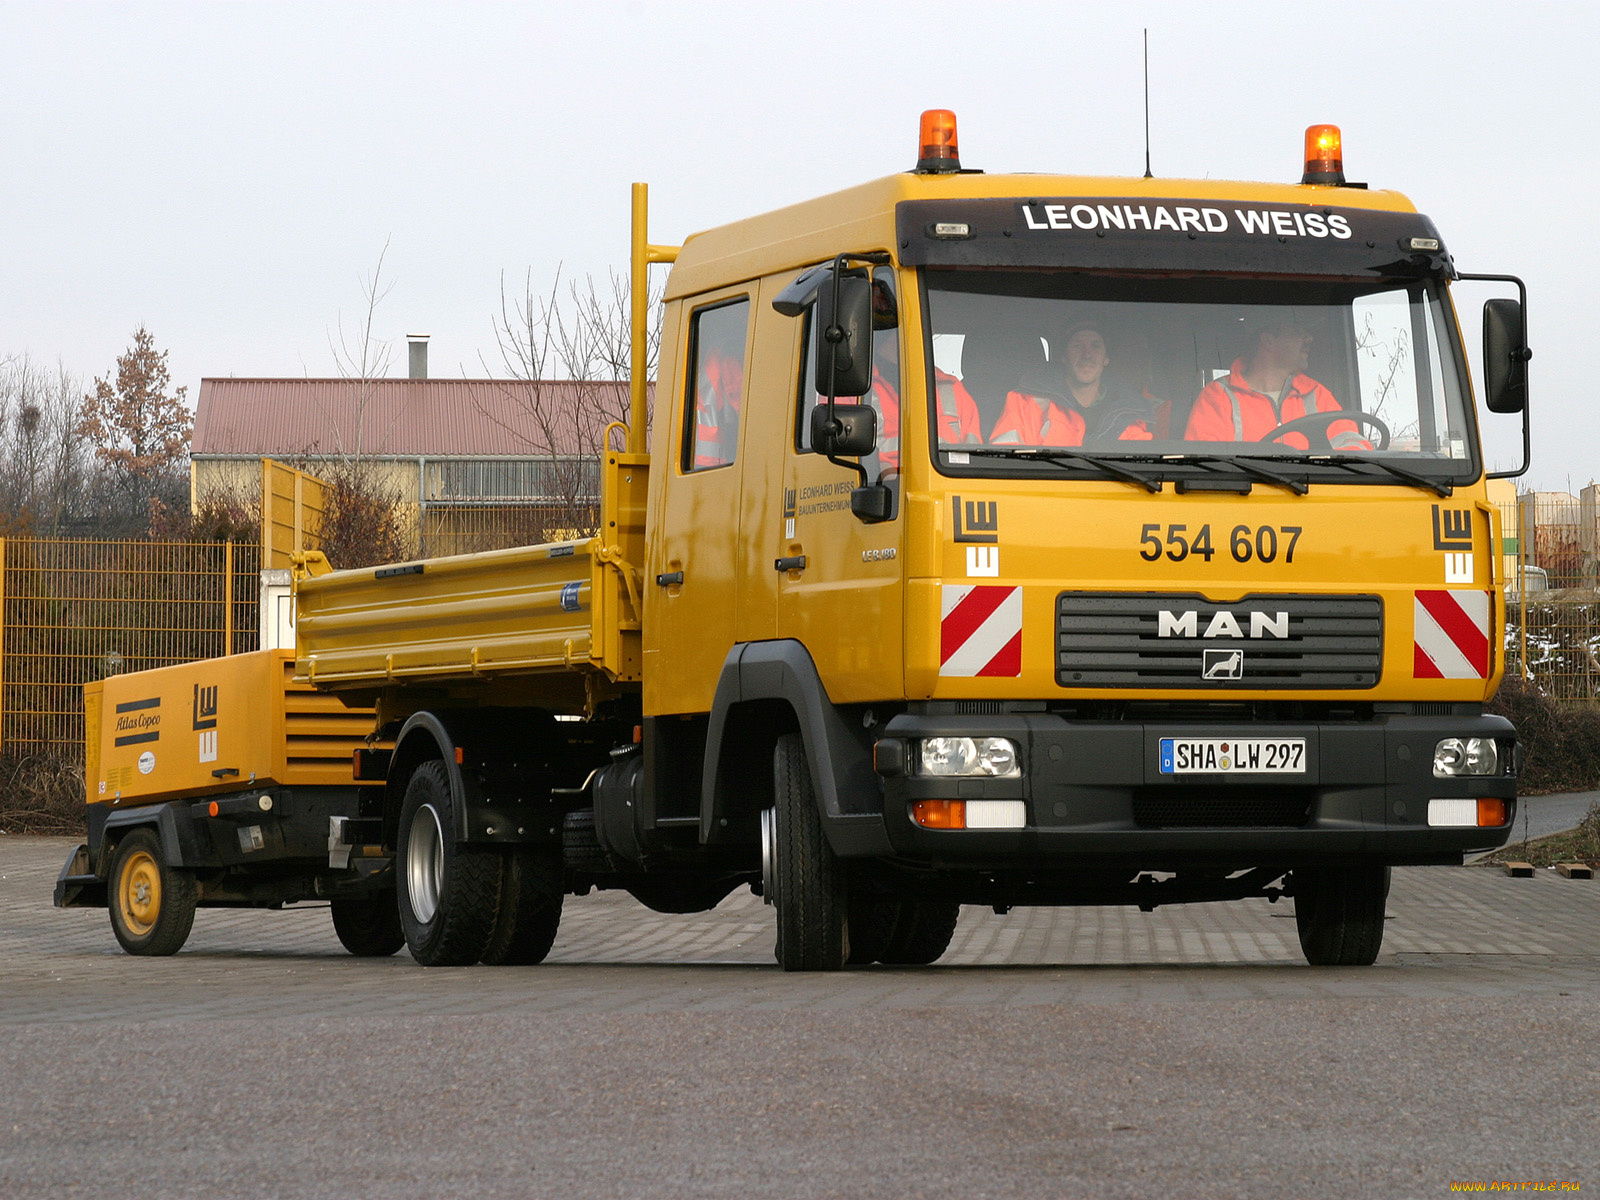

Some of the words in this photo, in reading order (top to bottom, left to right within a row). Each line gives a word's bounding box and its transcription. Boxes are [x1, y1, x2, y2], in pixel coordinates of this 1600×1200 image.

[1022, 204, 1228, 233] LEONHARD
[1234, 209, 1352, 240] WEISS
[799, 484, 833, 500] LEONHARD
[833, 480, 855, 495] WEISS
[798, 499, 853, 516] BAUUNTERNEHMUN
[1139, 524, 1215, 562] 554
[1230, 525, 1303, 563] 607
[1158, 610, 1289, 639] MAN
[115, 716, 138, 732] Atlas
[138, 713, 161, 729] Copco
[1177, 743, 1217, 769] SHA
[1234, 743, 1260, 769] LW
[1265, 743, 1304, 769] 297
